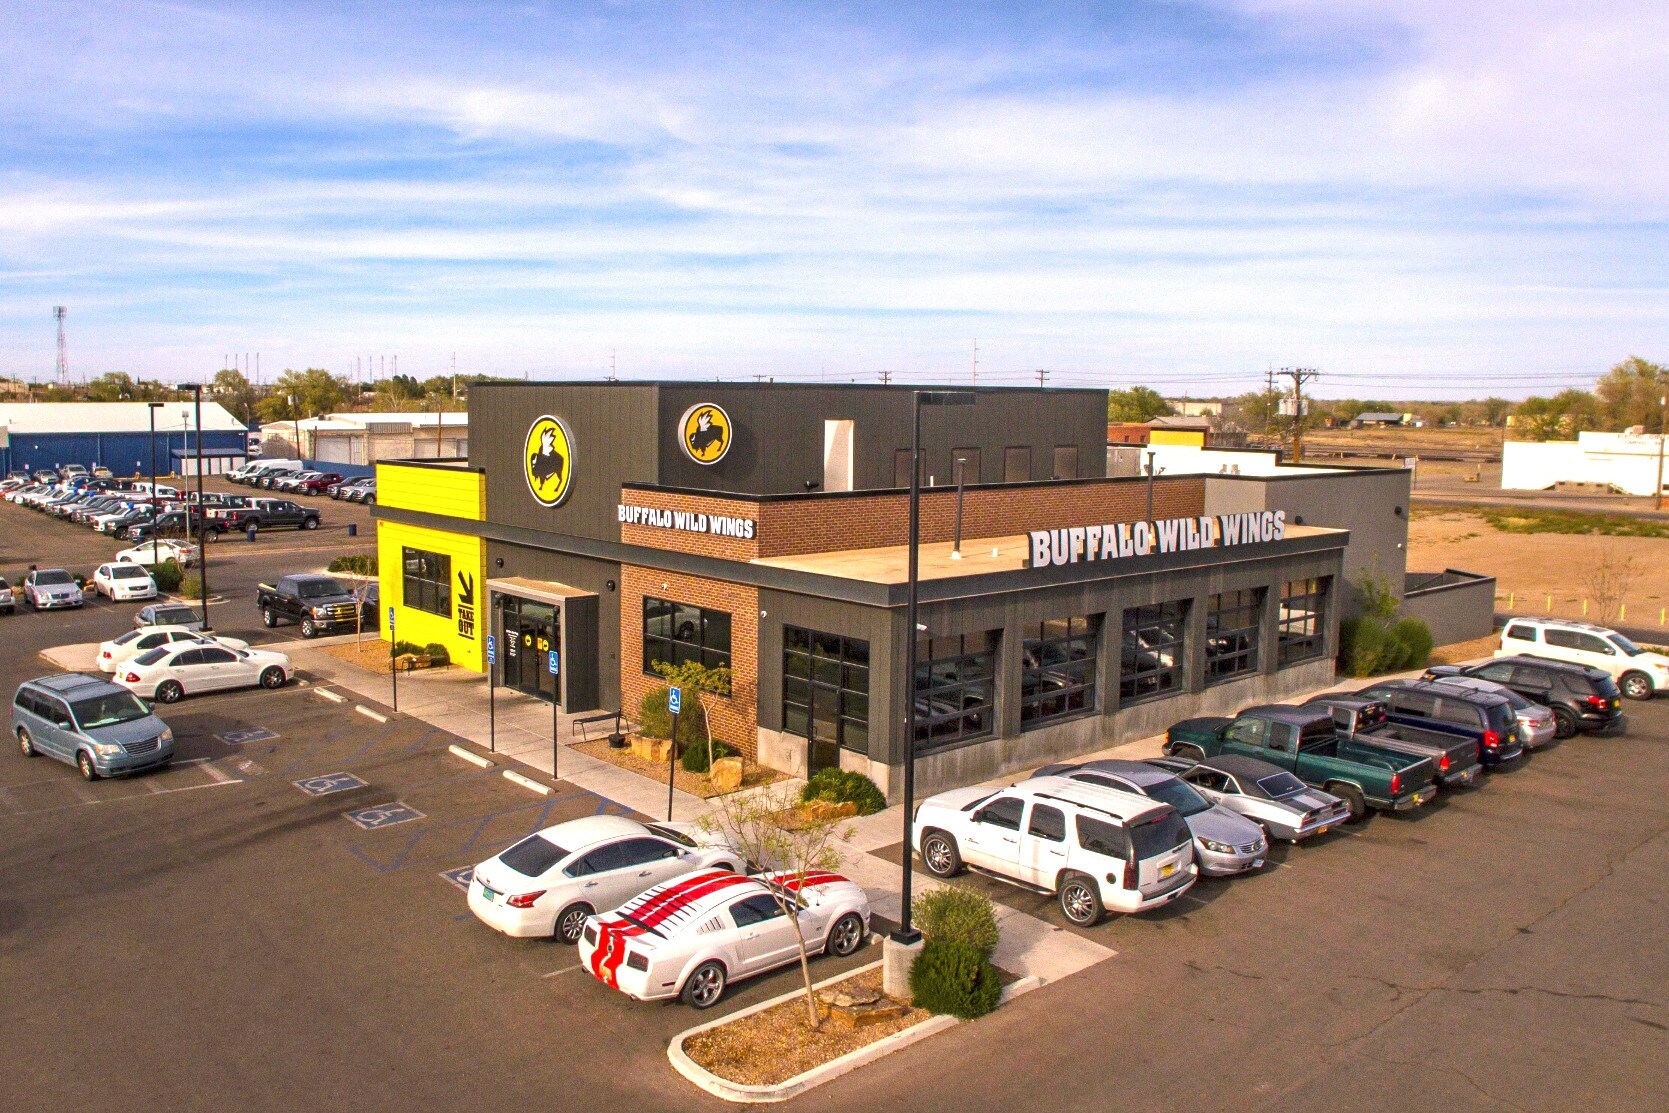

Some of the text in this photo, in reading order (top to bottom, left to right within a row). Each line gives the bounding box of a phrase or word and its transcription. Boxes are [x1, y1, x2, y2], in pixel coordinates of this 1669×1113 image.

[618, 505, 753, 538] BUFFALO WILD WINGS
[1030, 510, 1286, 568] BUFFALO WILD WINGS
[458, 607, 474, 622] TAKE
[458, 618, 474, 635] OUT
